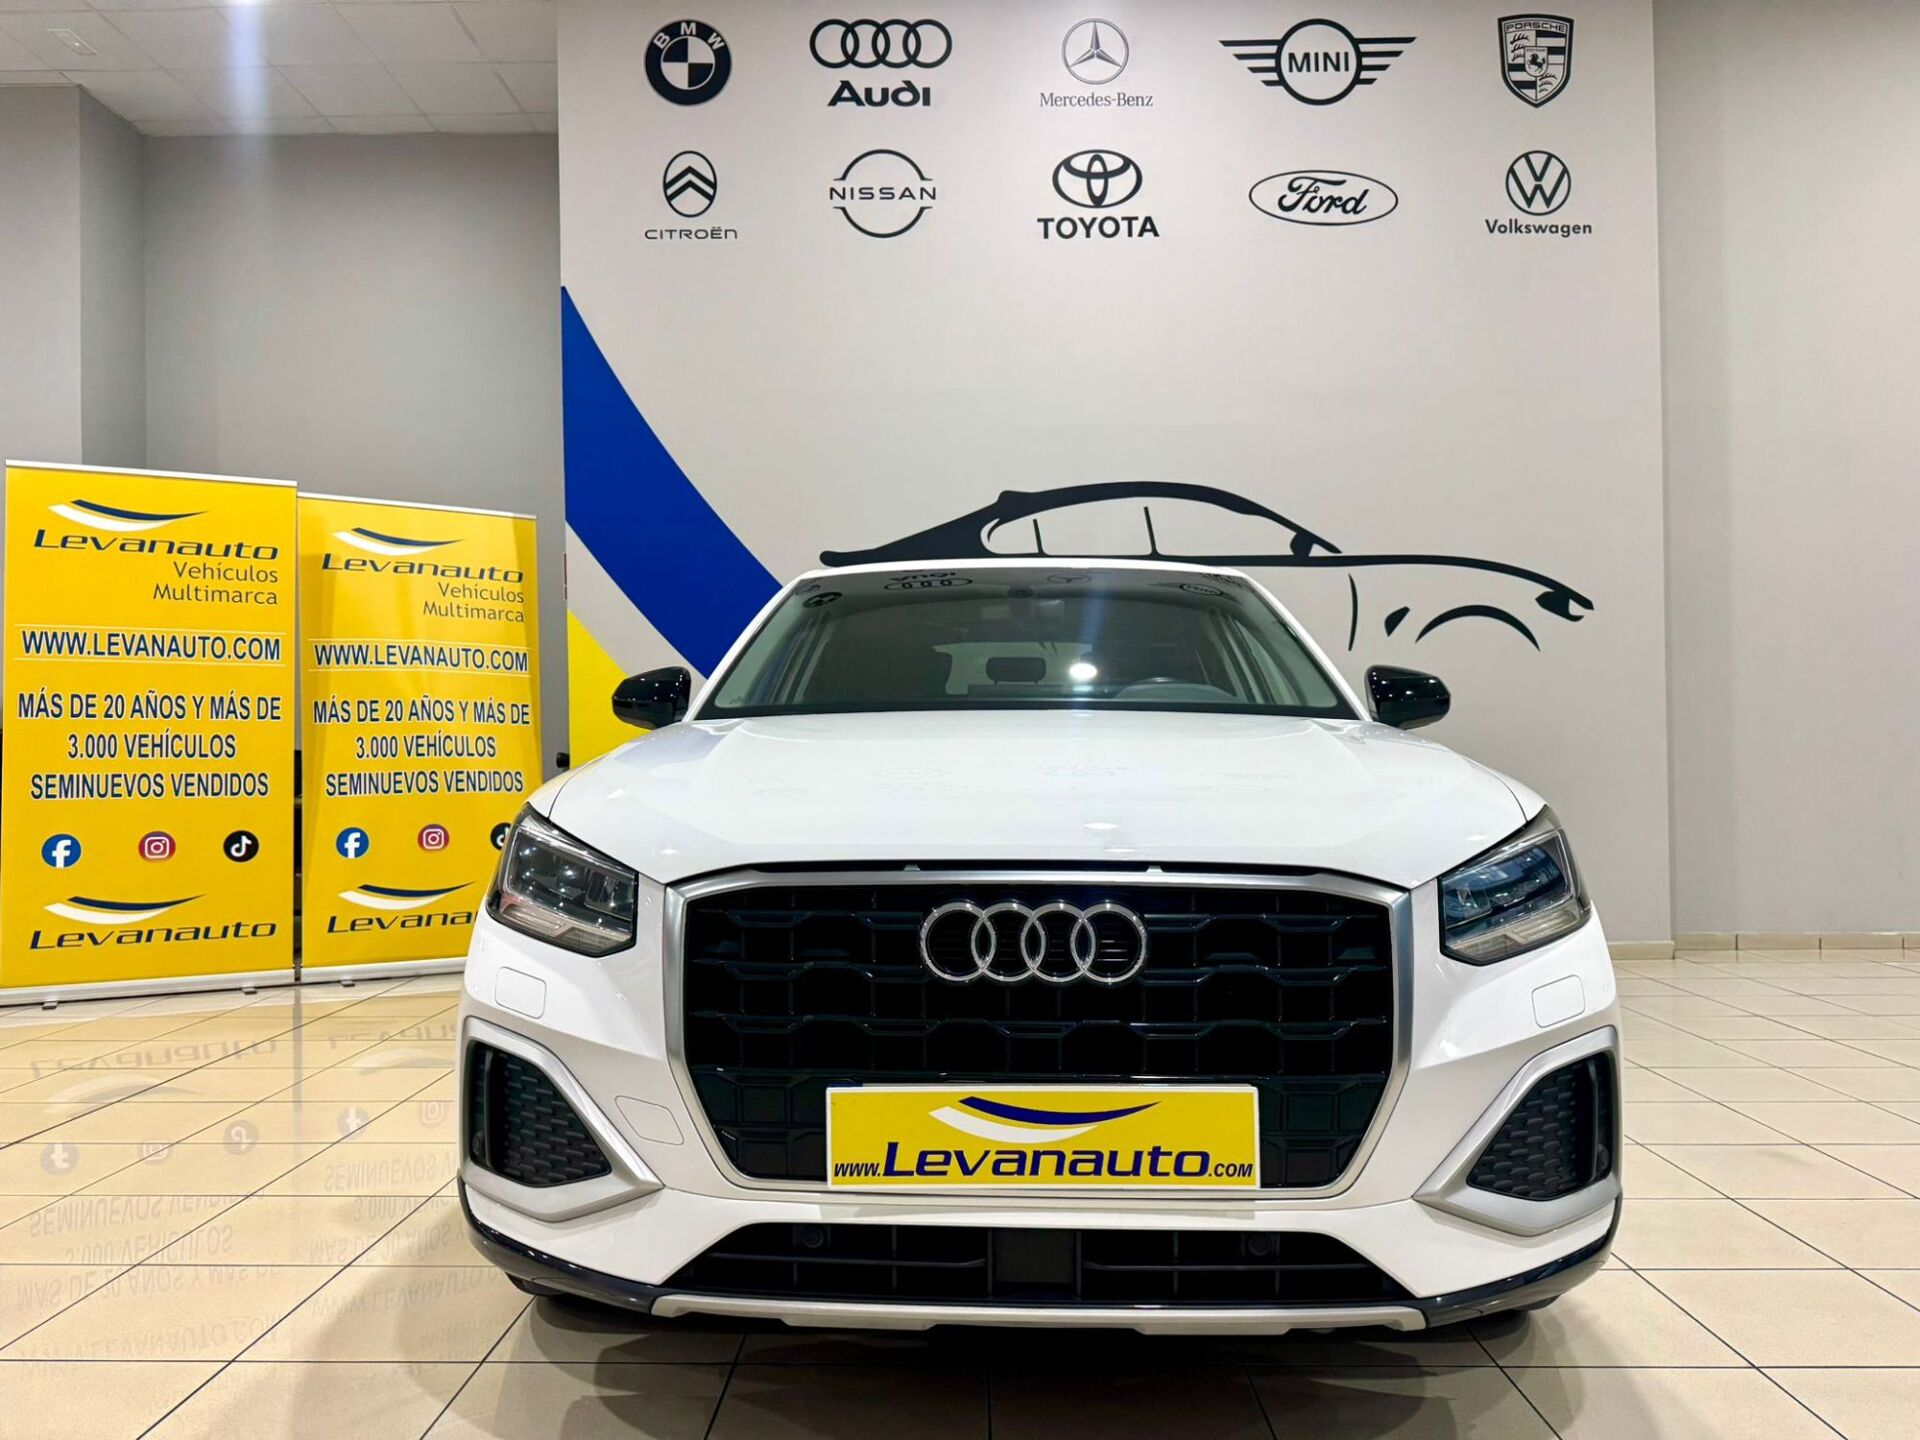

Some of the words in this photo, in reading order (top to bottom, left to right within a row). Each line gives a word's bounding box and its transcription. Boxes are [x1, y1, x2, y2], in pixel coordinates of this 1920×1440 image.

[653, 21, 725, 51] BMW
[1506, 21, 1567, 32] PORSCHE
[1287, 52, 1350, 73] MINI
[826, 80, 931, 107] Audi
[1039, 92, 1154, 108] Mercedes-Benz
[829, 186, 936, 201] NISSAN
[1277, 175, 1370, 216] Ford
[644, 226, 738, 240] CITROËN
[1036, 216, 1160, 240] TOYOTA
[1485, 219, 1593, 238] Volkswagen
[34, 529, 279, 561] Levanauto
[173, 561, 279, 584] Vehículos
[322, 553, 523, 583] Levanauto
[153, 583, 278, 605] Multimarca
[438, 581, 525, 603] Vehículos
[424, 600, 525, 623] Multimarca
[22, 630, 280, 661] WWW.LEVANAUTO.COM
[314, 644, 528, 672] WWW.LEVANAUTO.COM
[18, 687, 63, 719] MÁS
[70, 693, 97, 719] DE
[103, 694, 125, 719] 20
[130, 689, 186, 720] AÑOS
[192, 695, 205, 720] Y
[210, 690, 251, 721] MÁS
[256, 696, 281, 721] DE
[313, 695, 352, 724] MÁS
[356, 699, 380, 723] DE
[385, 699, 404, 722] 20
[408, 696, 455, 722] AÑOS
[459, 701, 469, 722] Y
[473, 698, 506, 724] MÁS
[510, 703, 530, 725] DE
[68, 734, 118, 759] 3.000
[123, 729, 236, 759] VEHÍCULOS
[356, 735, 398, 759] 3.000
[403, 730, 496, 758] VEHÍCULOS
[30, 773, 165, 800] SEMINUEVOS
[170, 772, 269, 797] VENDIDOS
[325, 770, 439, 797] SEMINUEVOS
[443, 770, 524, 793] VENDIDOS
[327, 910, 478, 933] Levana
[29, 921, 277, 950] Levanauto
